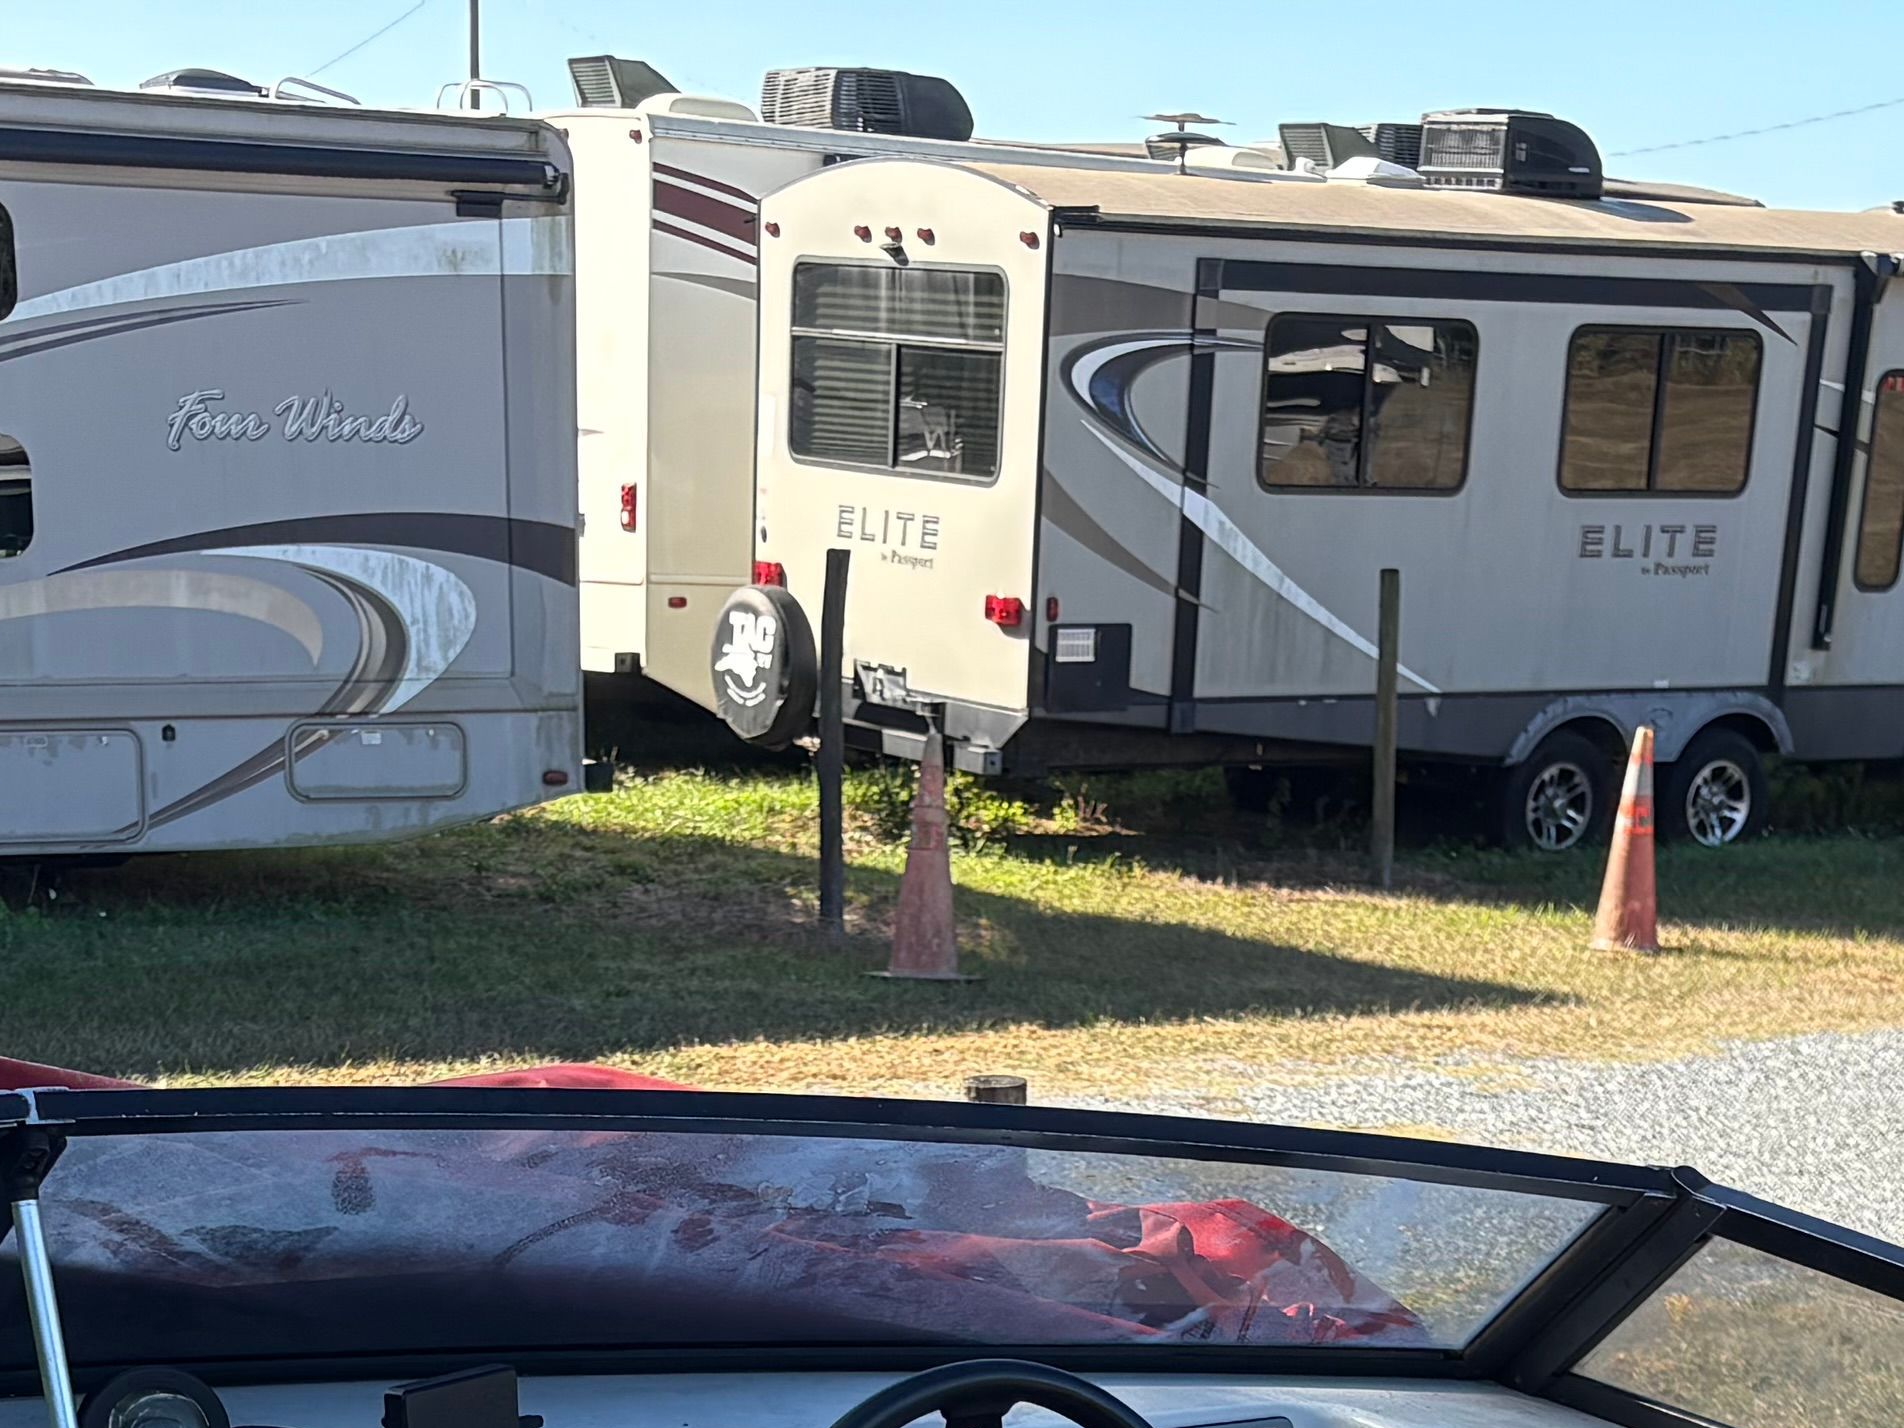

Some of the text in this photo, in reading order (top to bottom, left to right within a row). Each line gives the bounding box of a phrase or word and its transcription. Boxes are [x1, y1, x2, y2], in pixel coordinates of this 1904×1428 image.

[167, 385, 424, 451] Four Winds
[836, 504, 940, 550] ELITE
[1578, 524, 1718, 559] ELITE
